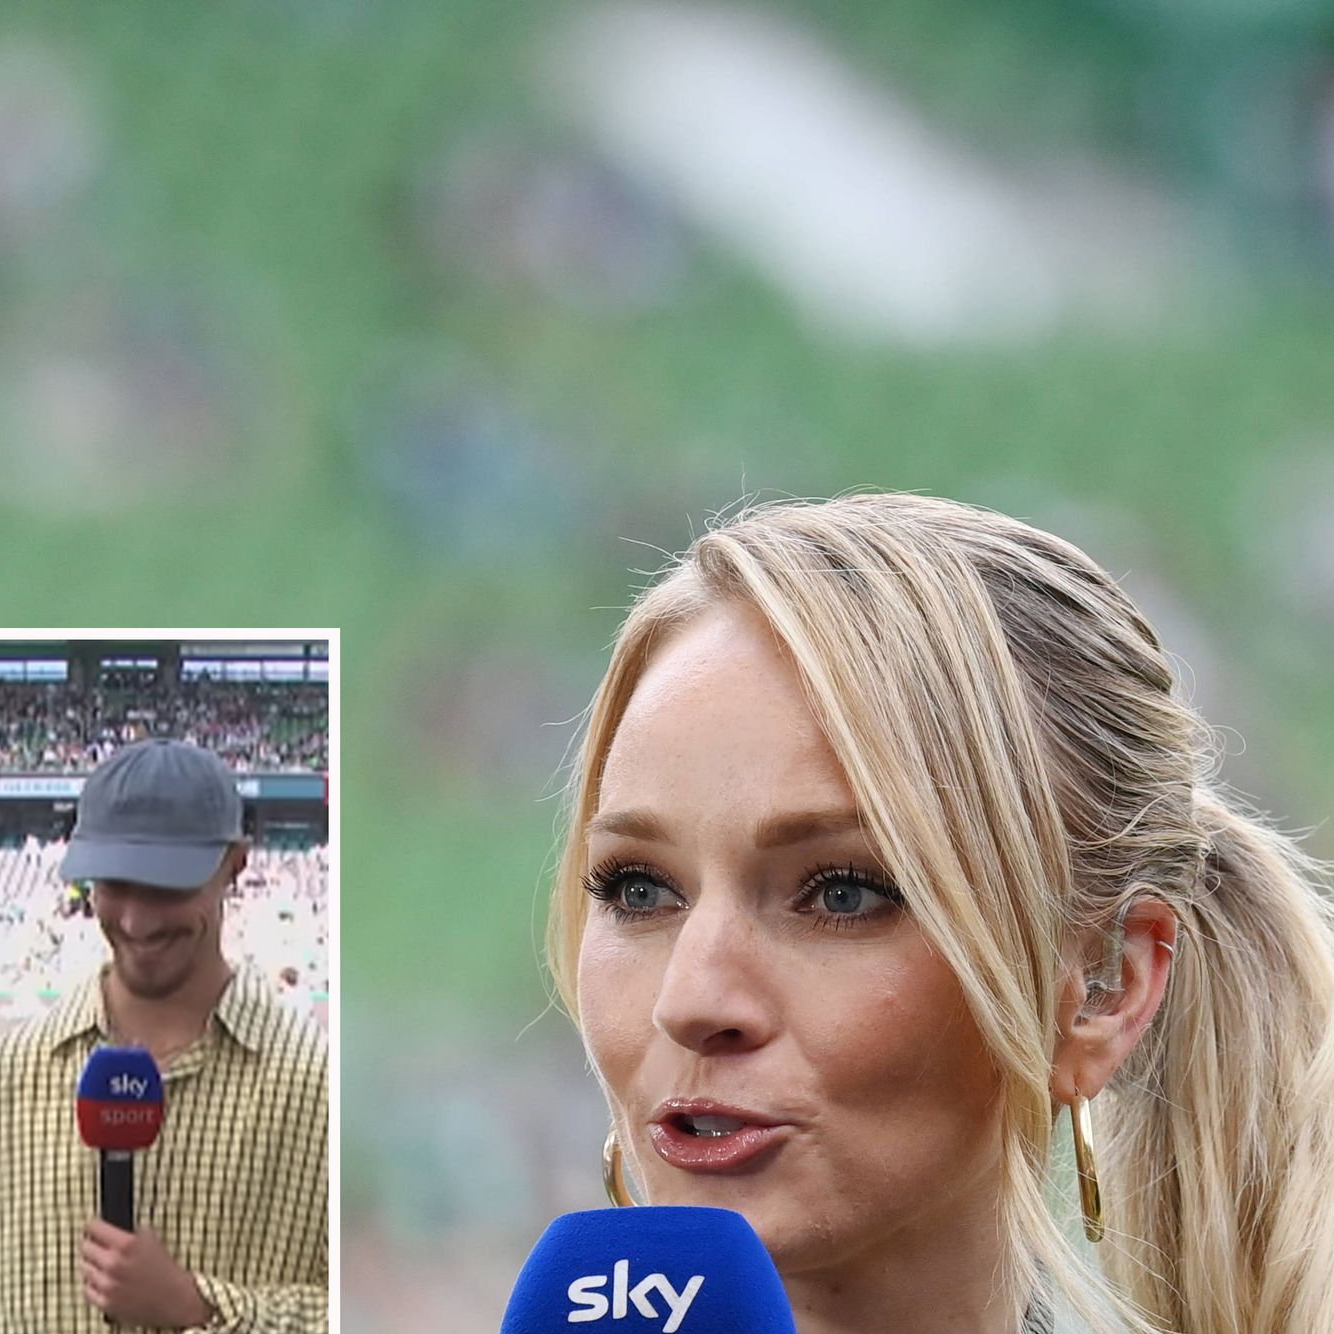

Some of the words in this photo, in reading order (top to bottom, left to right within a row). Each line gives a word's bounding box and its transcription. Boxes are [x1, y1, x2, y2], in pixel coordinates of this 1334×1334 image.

[109, 1072, 149, 1099] sky
[99, 1107, 155, 1125] sport
[567, 1258, 706, 1334] sky
